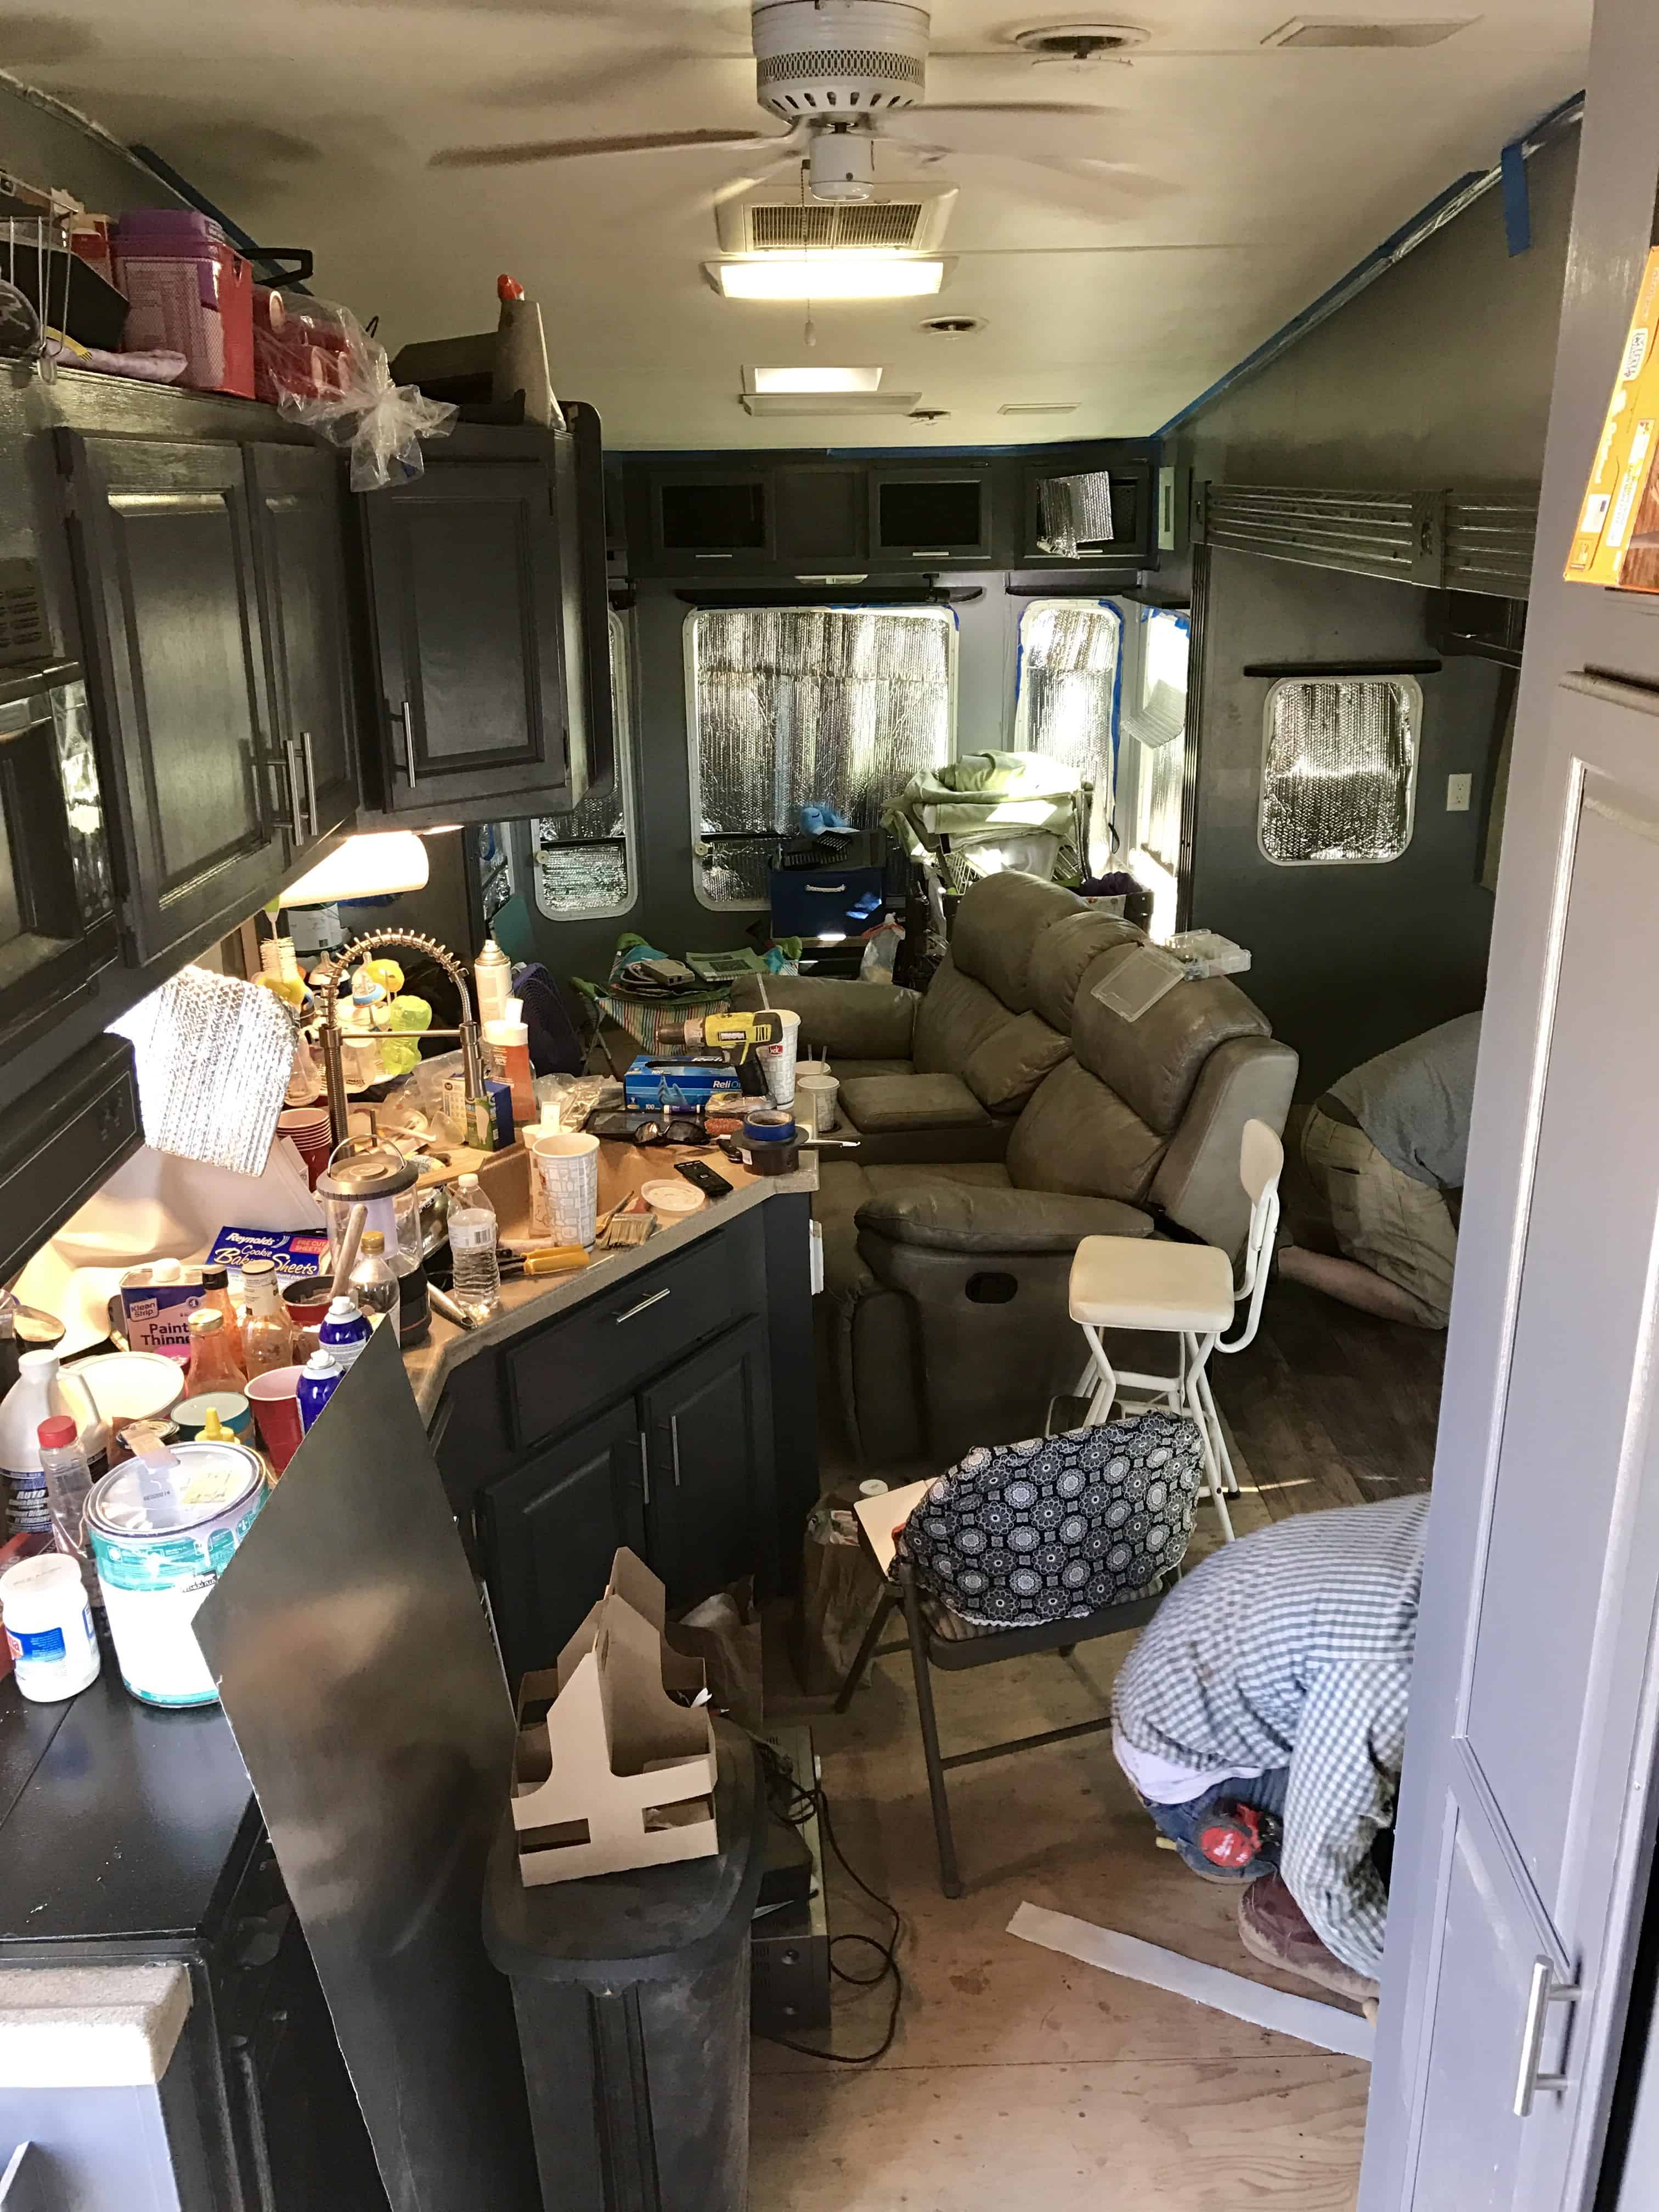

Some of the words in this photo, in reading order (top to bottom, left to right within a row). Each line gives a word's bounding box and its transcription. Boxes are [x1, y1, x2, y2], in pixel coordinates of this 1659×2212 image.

[225, 1233, 276, 1246] Reynolds
[241, 1245, 273, 1257] Cookie
[272, 1253, 318, 1276] Sheets
[131, 1302, 156, 1313] Klean
[134, 1309, 154, 1318] Strip
[149, 1323, 190, 1334] Paint
[16, 1489, 47, 1500] AUTO
